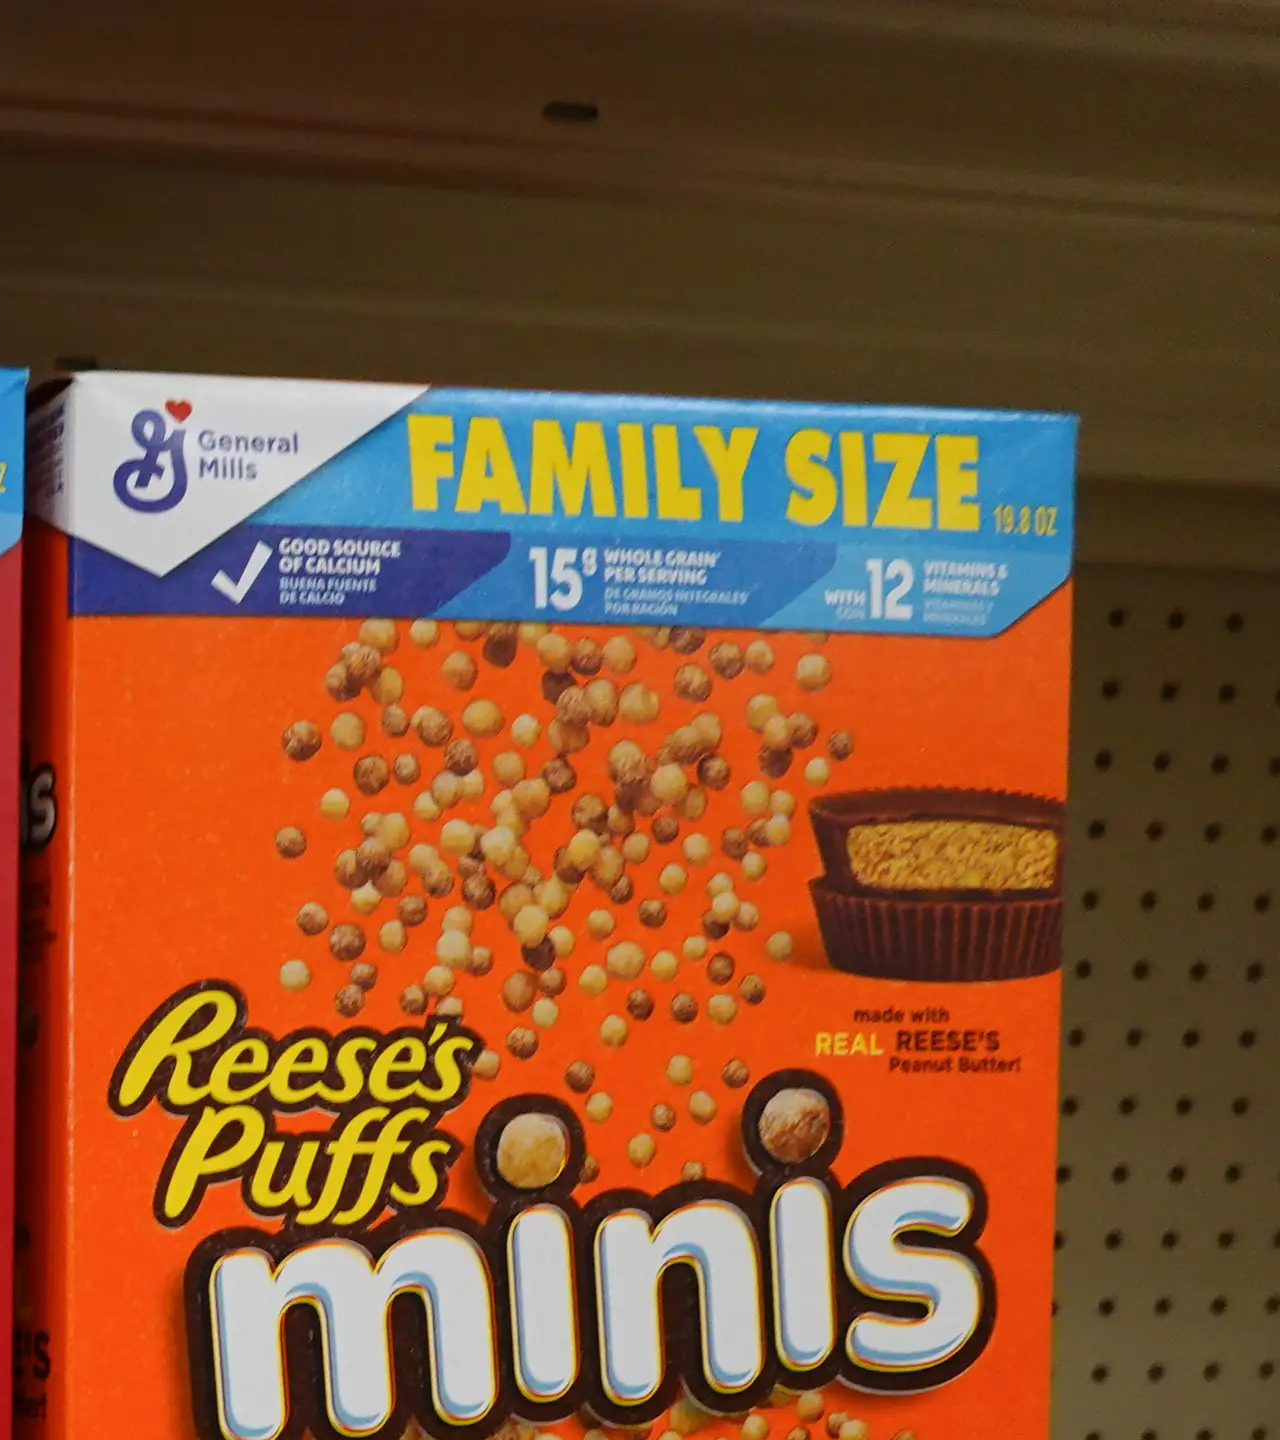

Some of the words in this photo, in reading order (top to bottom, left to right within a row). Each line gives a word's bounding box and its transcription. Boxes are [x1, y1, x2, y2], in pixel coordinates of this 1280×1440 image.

[198, 430, 298, 455] General
[198, 458, 257, 480] Mills
[407, 413, 760, 522] FAMILY
[785, 428, 983, 532] SIZE
[993, 505, 1032, 535] 19.8
[1035, 508, 1057, 536] OZ
[865, 558, 913, 620] 12
[854, 1008, 904, 1022] made
[911, 1006, 950, 1022] with
[116, 987, 477, 1109] Reese's
[814, 1032, 884, 1056] REAL
[896, 1030, 1000, 1050] REESE'S
[889, 1057, 952, 1072] Peanut
[161, 1105, 451, 1226] Puffs
